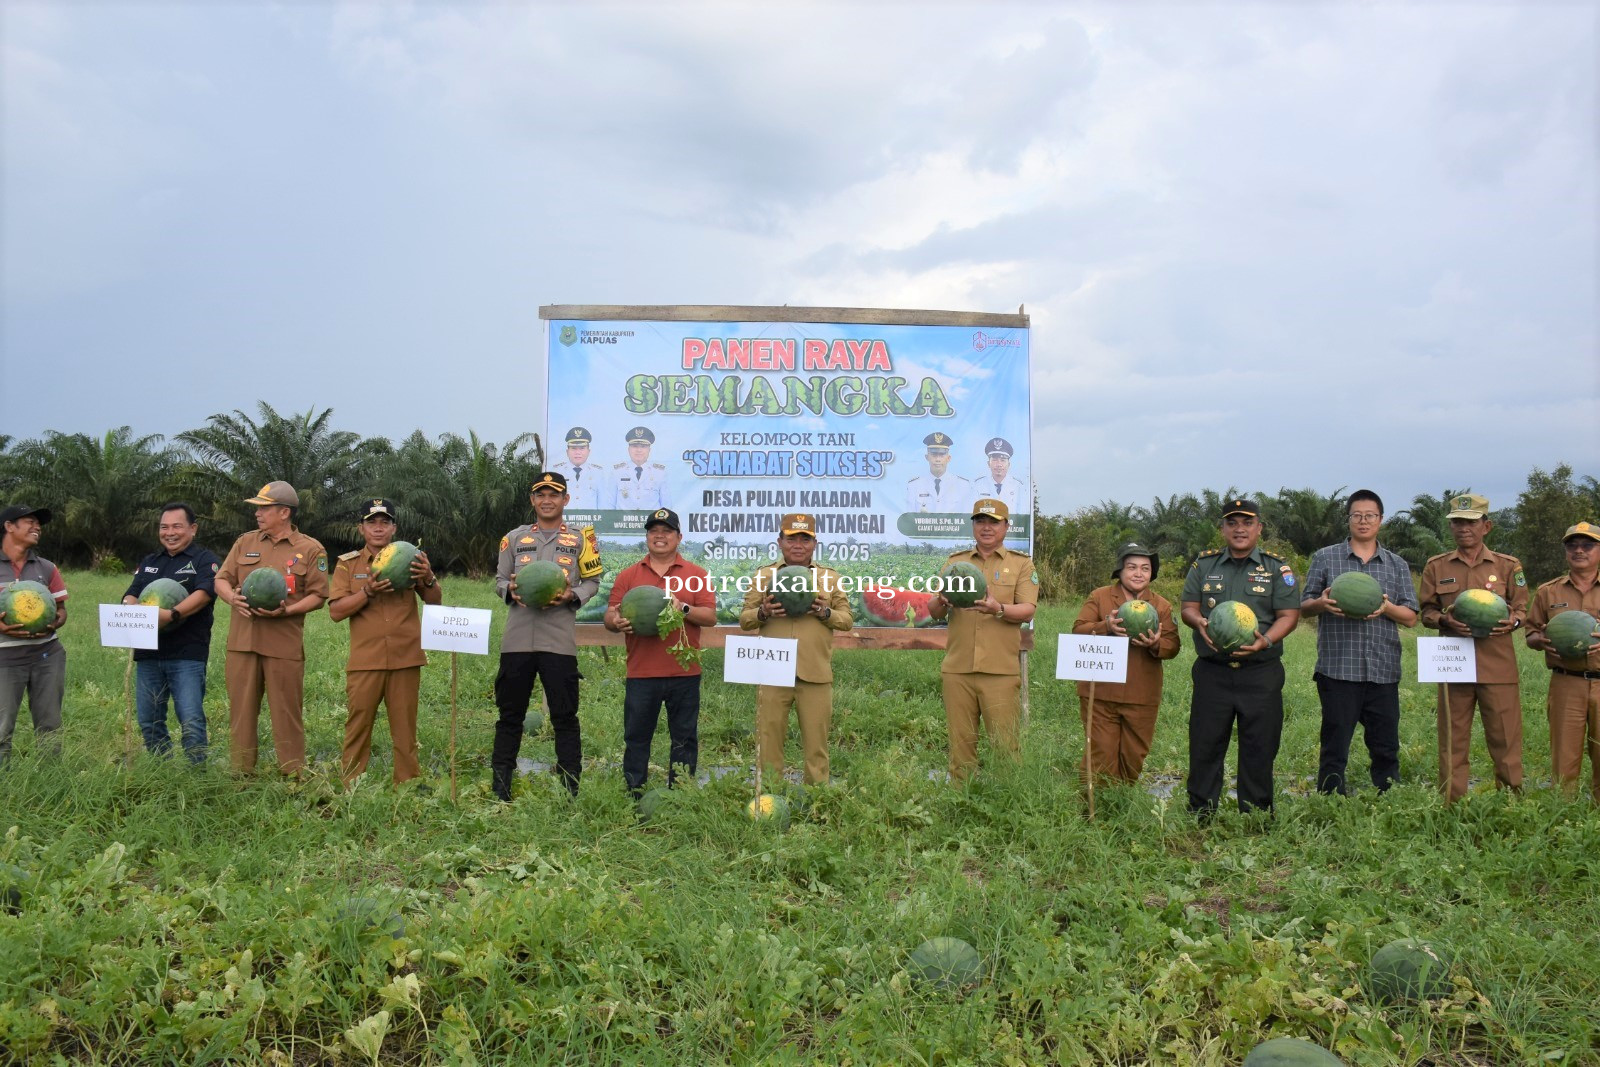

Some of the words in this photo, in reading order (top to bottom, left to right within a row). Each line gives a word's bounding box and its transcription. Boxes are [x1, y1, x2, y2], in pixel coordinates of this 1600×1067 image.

[682, 338, 796, 371] PANEN
[803, 339, 892, 371] RAYA
[624, 374, 955, 416] SEMANGKA
[720, 432, 812, 446] KELOMPOK
[817, 433, 855, 446] TANI
[703, 490, 742, 507] DESA
[746, 490, 796, 507] PULAU
[799, 491, 872, 508] KALADAN
[555, 546, 577, 554] POLRI
[704, 542, 762, 562] Selasa,
[768, 542, 778, 561] 8
[828, 544, 870, 561] 2025
[114, 611, 147, 619] KAPOLRES
[129, 621, 155, 630] KAPUAS
[442, 616, 470, 626] DPRD
[432, 629, 478, 639] KAB.KAPUAS
[1078, 643, 1113, 655] WAKIL
[1437, 644, 1461, 652] DANDIM
[737, 647, 790, 662] BUPATI
[1075, 660, 1114, 671] BUPATI
